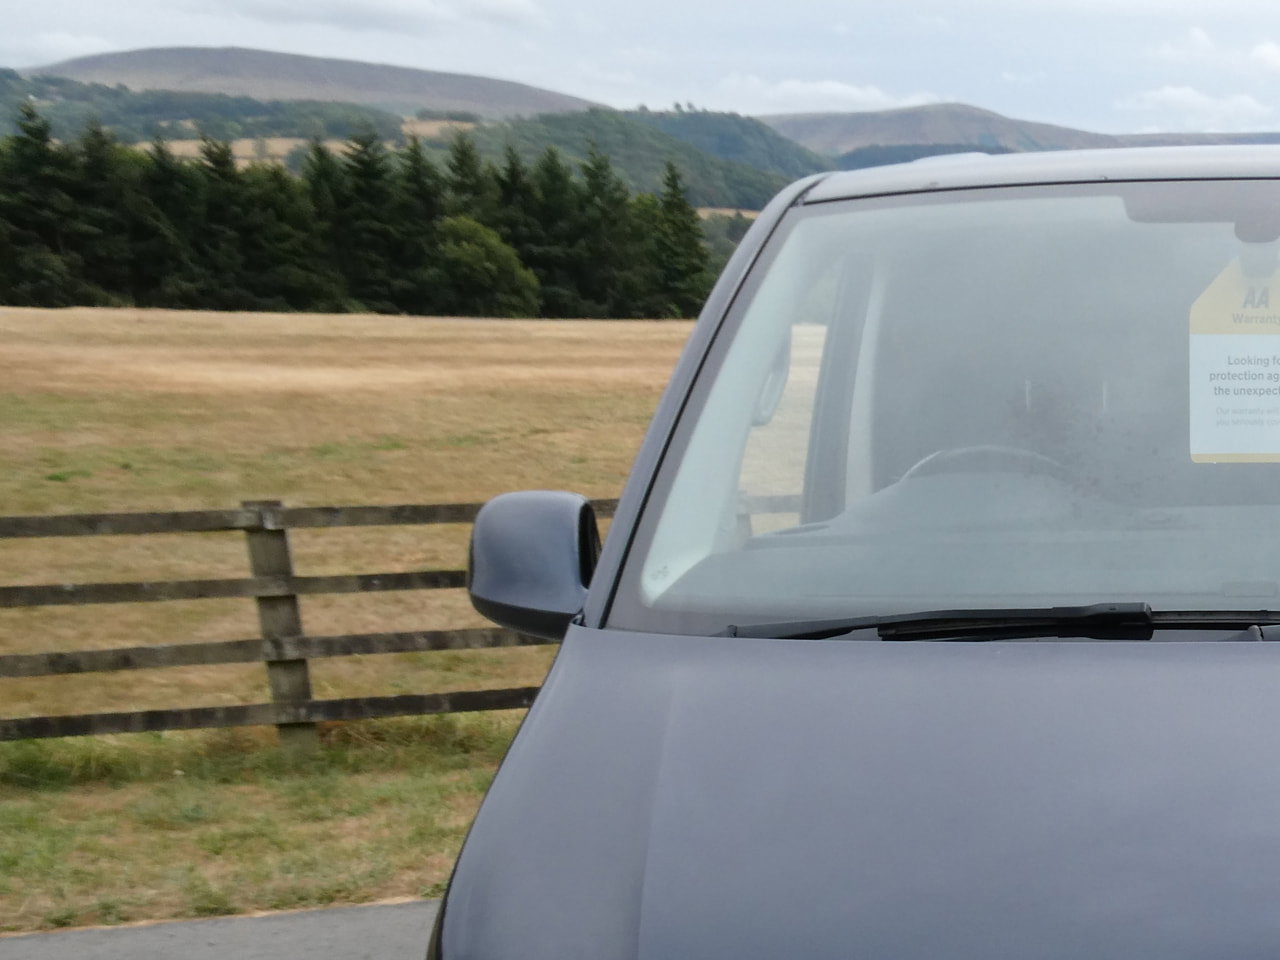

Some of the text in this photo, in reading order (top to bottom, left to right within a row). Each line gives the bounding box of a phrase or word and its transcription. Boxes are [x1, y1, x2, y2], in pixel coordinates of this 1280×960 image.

[1242, 287, 1269, 308] AA
[1228, 355, 1270, 367] Looking
[1209, 371, 1264, 382] protection
[1214, 386, 1231, 395] the
